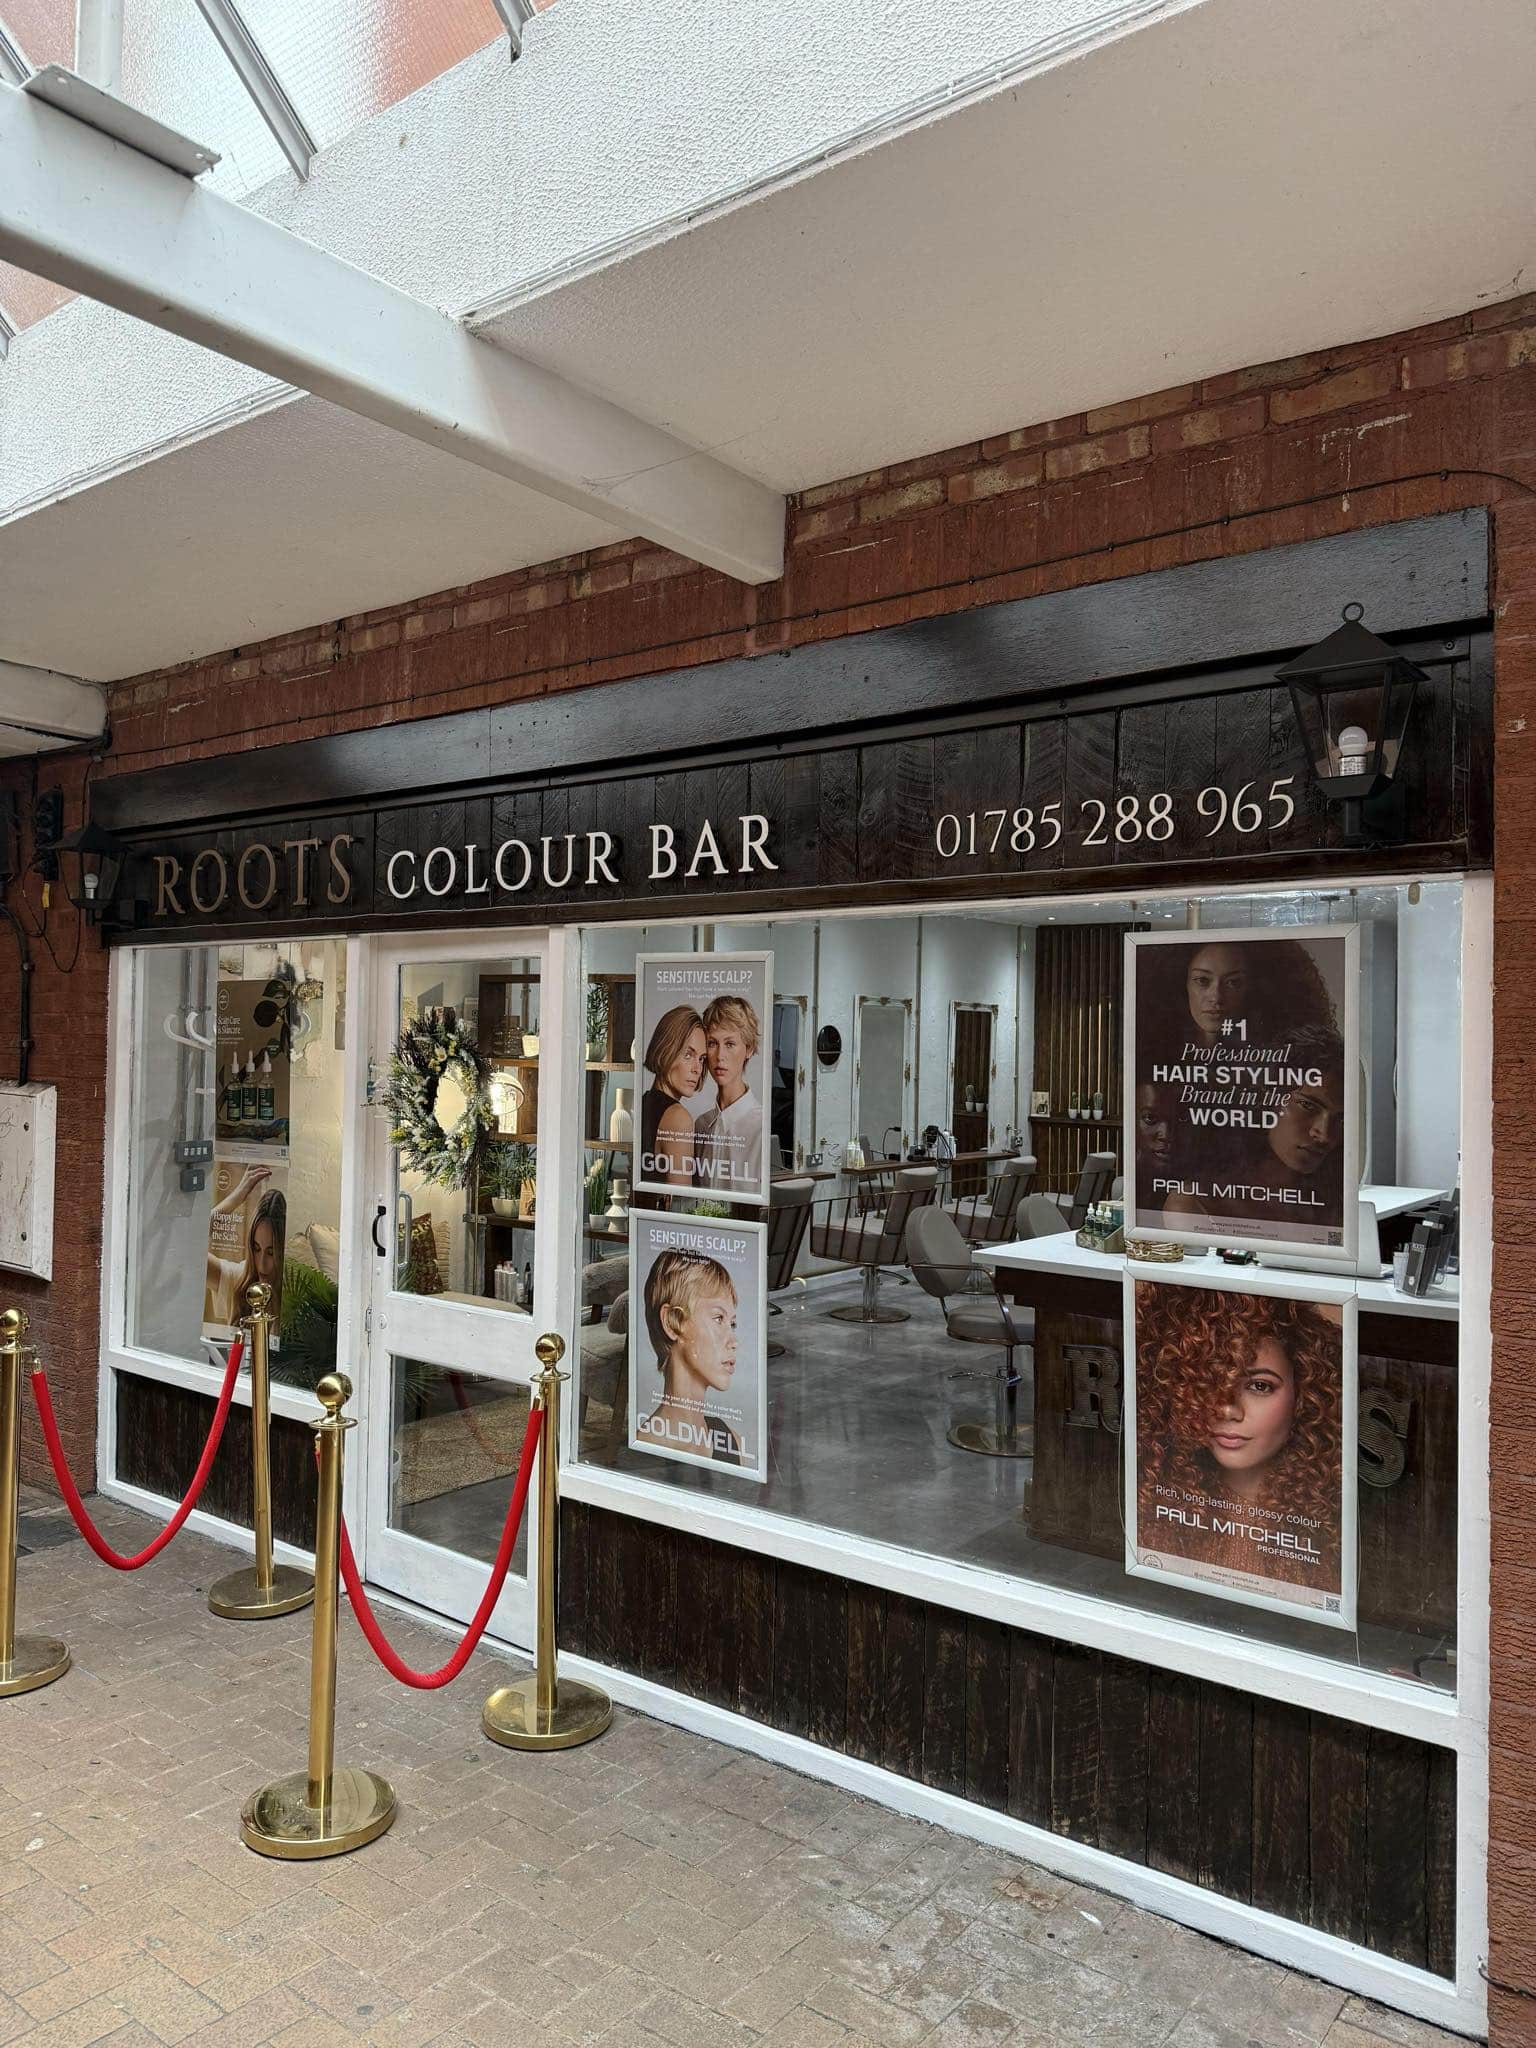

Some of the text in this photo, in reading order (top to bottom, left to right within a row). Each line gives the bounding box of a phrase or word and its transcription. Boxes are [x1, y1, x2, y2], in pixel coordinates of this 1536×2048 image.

[935, 775, 1296, 858] 01785 288 965
[153, 814, 780, 916] ROOTS COLOUR BAR
[656, 970, 753, 984] SENSITIVE SCALP?
[1221, 1018, 1247, 1041] #1
[1181, 1043, 1291, 1065] Professional
[1153, 1064, 1323, 1087] HAIR STYLING
[1180, 1085, 1291, 1106] Brand in the
[641, 1152, 758, 1182] GOLDWELL
[1153, 1179, 1325, 1206] PAUL MITCHELL
[649, 1229, 704, 1248] SENSITIVE
[706, 1236, 747, 1254] SCALP?
[637, 1412, 755, 1459] GOLDWELL
[1156, 1484, 1179, 1500] Rich,
[1248, 1506, 1284, 1523] glossy
[1286, 1513, 1322, 1528] colour
[1156, 1505, 1321, 1554] PAUL MITCHELL
[1257, 1544, 1321, 1565] PROFESSIONAL
